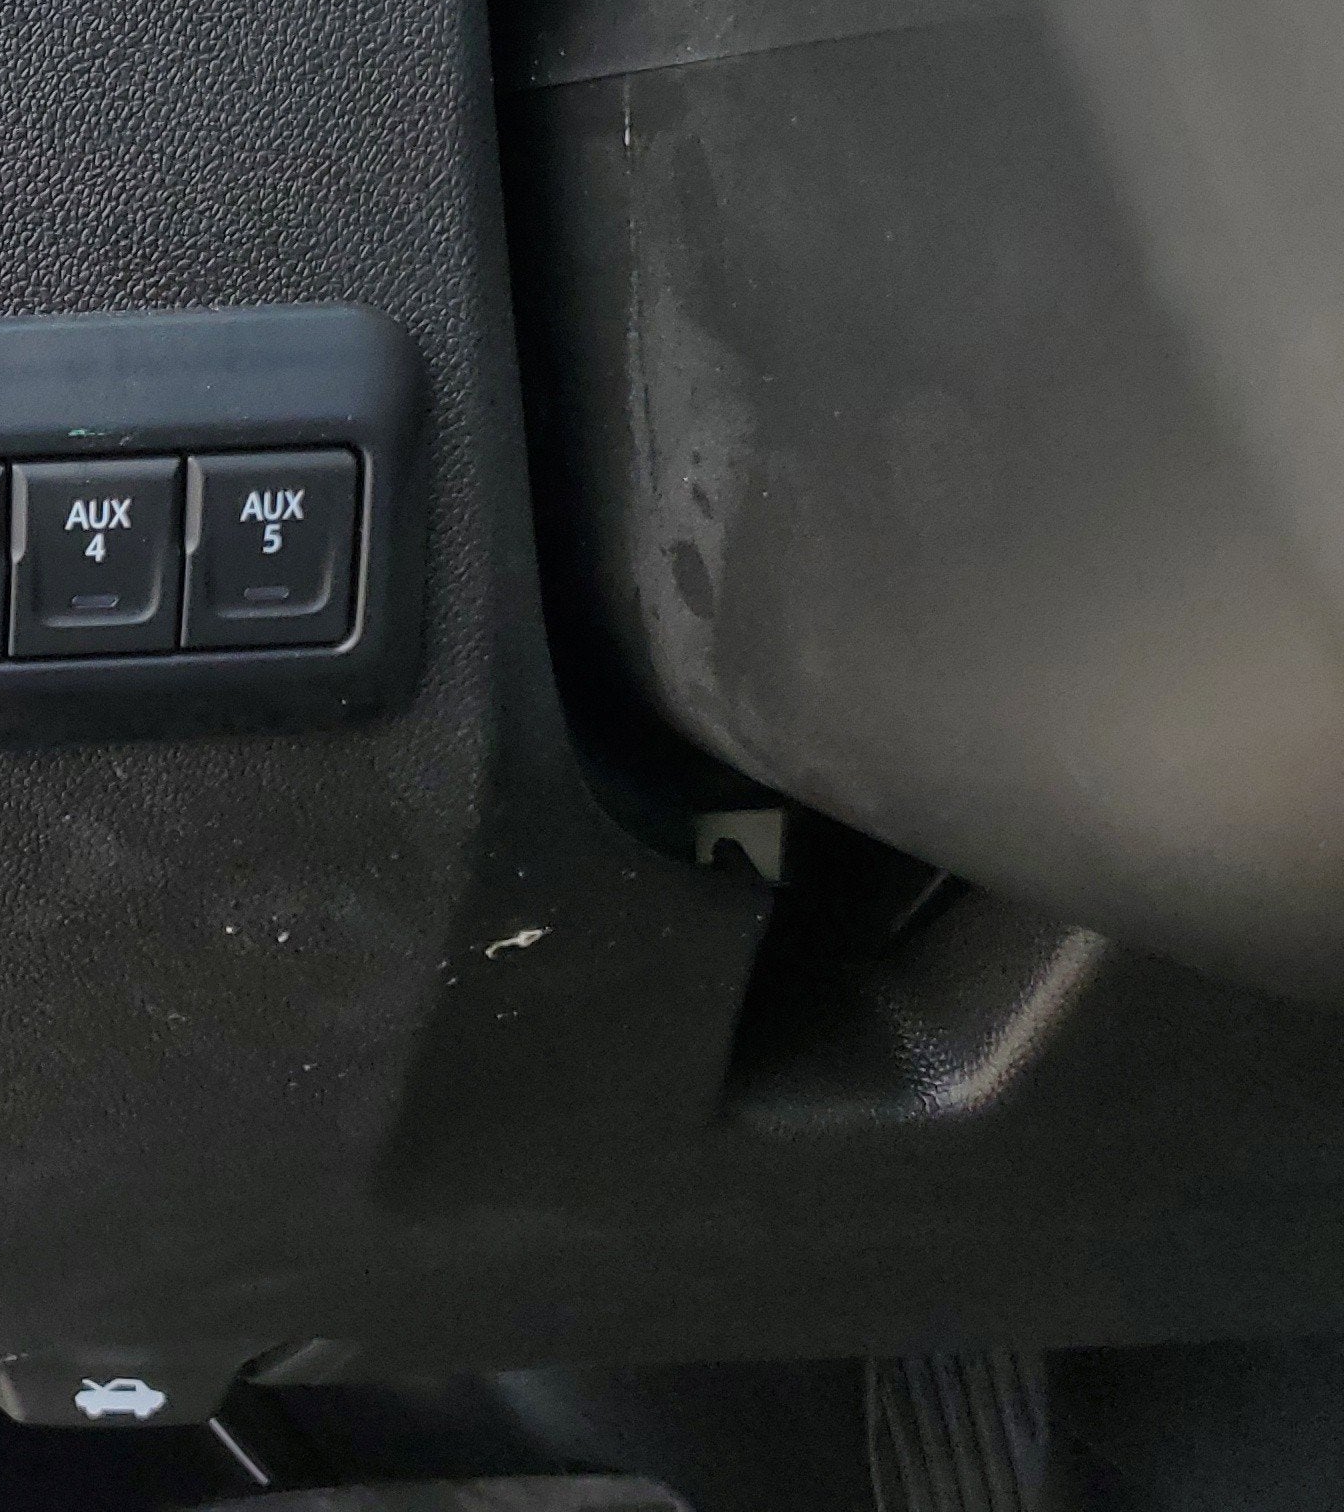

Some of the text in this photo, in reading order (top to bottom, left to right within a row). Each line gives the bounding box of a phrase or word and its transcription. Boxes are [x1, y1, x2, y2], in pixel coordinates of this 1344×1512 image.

[64, 497, 132, 531] AUX
[239, 488, 305, 523] AUX
[83, 531, 107, 563] 4
[261, 523, 283, 555] 5
